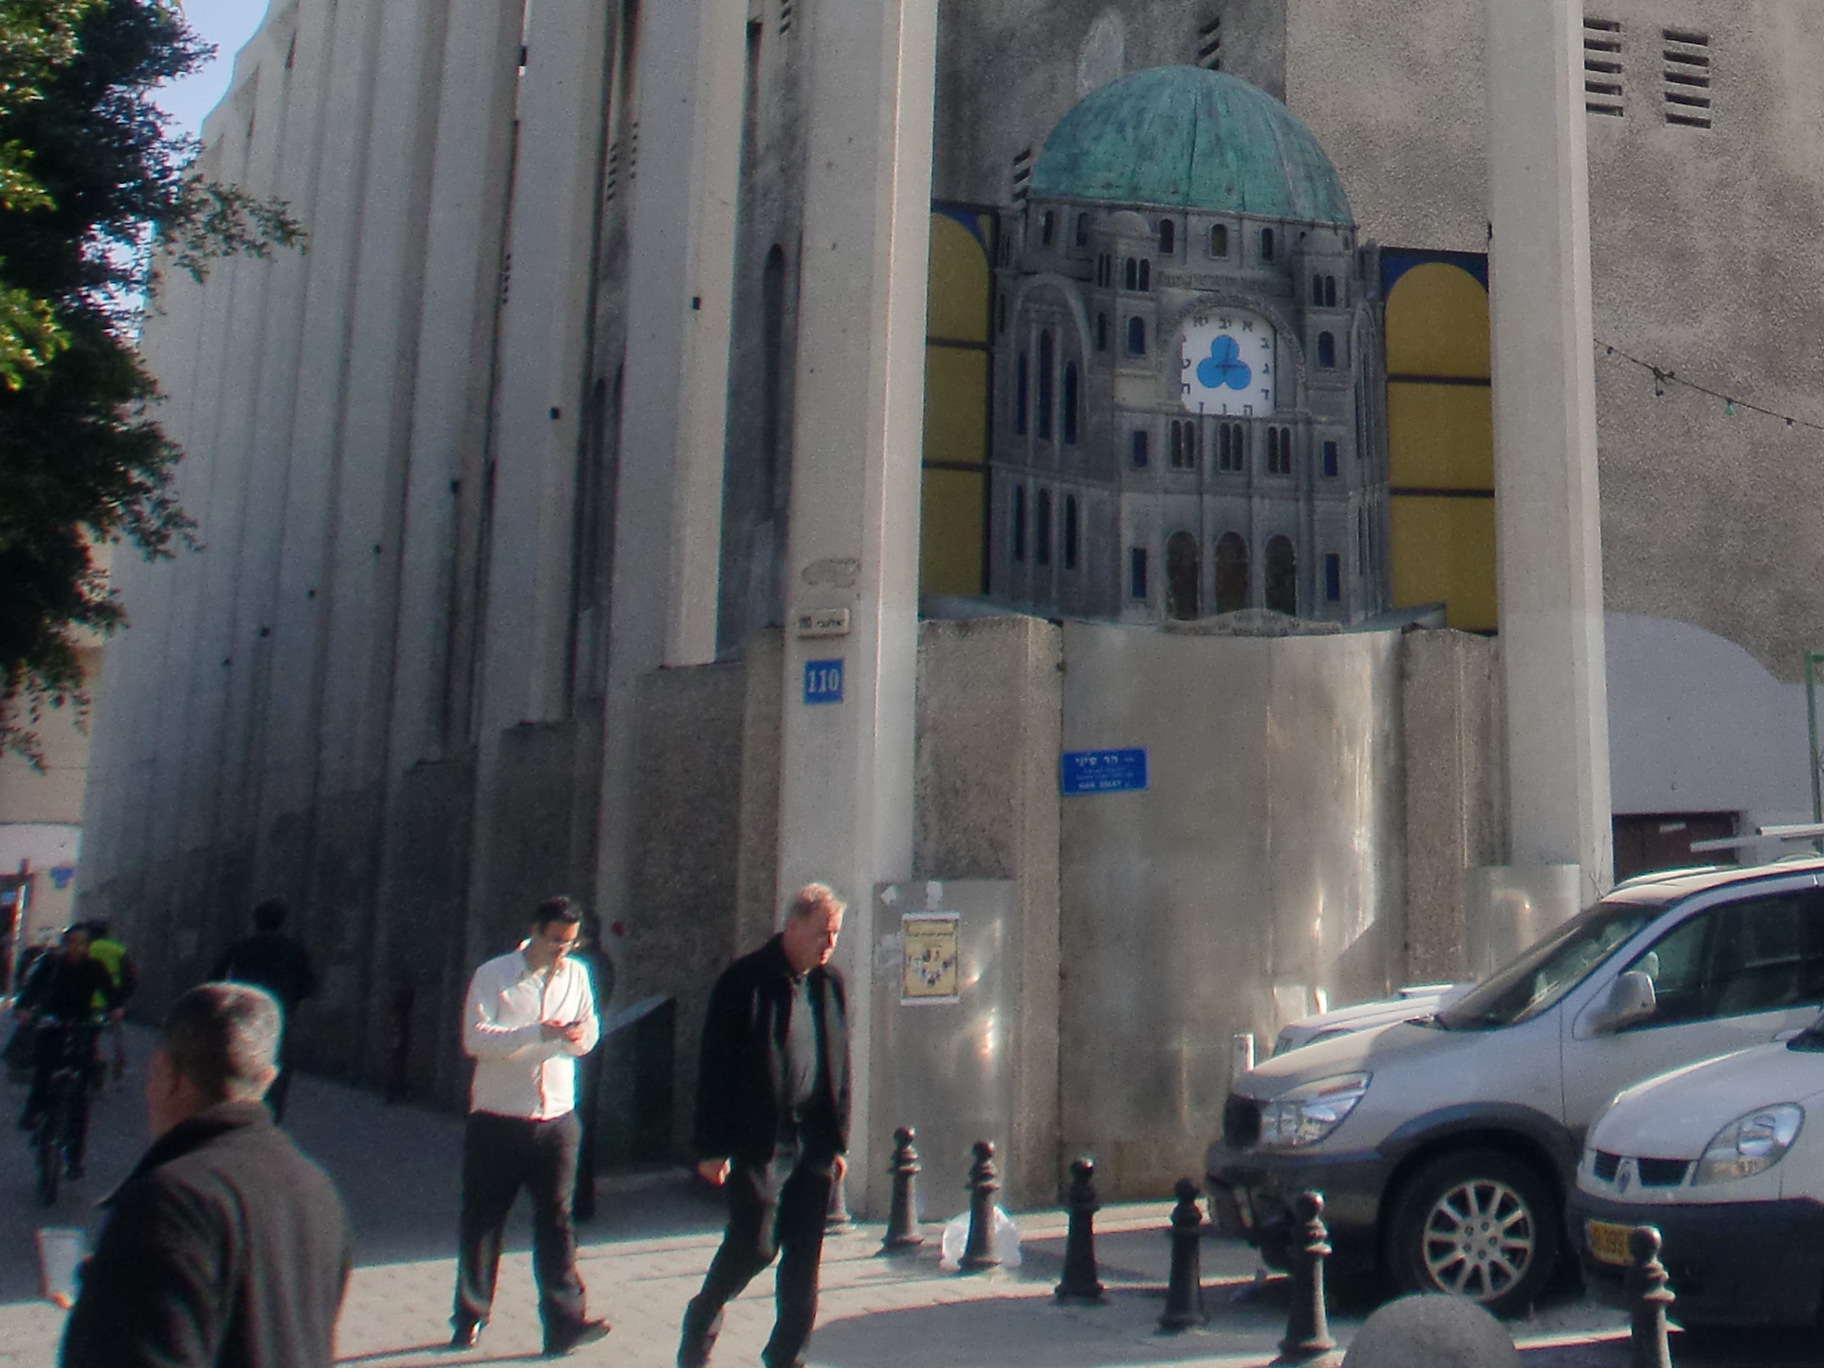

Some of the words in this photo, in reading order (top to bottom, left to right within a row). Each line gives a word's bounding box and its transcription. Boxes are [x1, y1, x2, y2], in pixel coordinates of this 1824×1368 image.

[1242, 319, 1253, 332] א
[1261, 337, 1270, 349] ב
[1262, 363, 1270, 374] ג
[808, 669, 840, 693] 110
